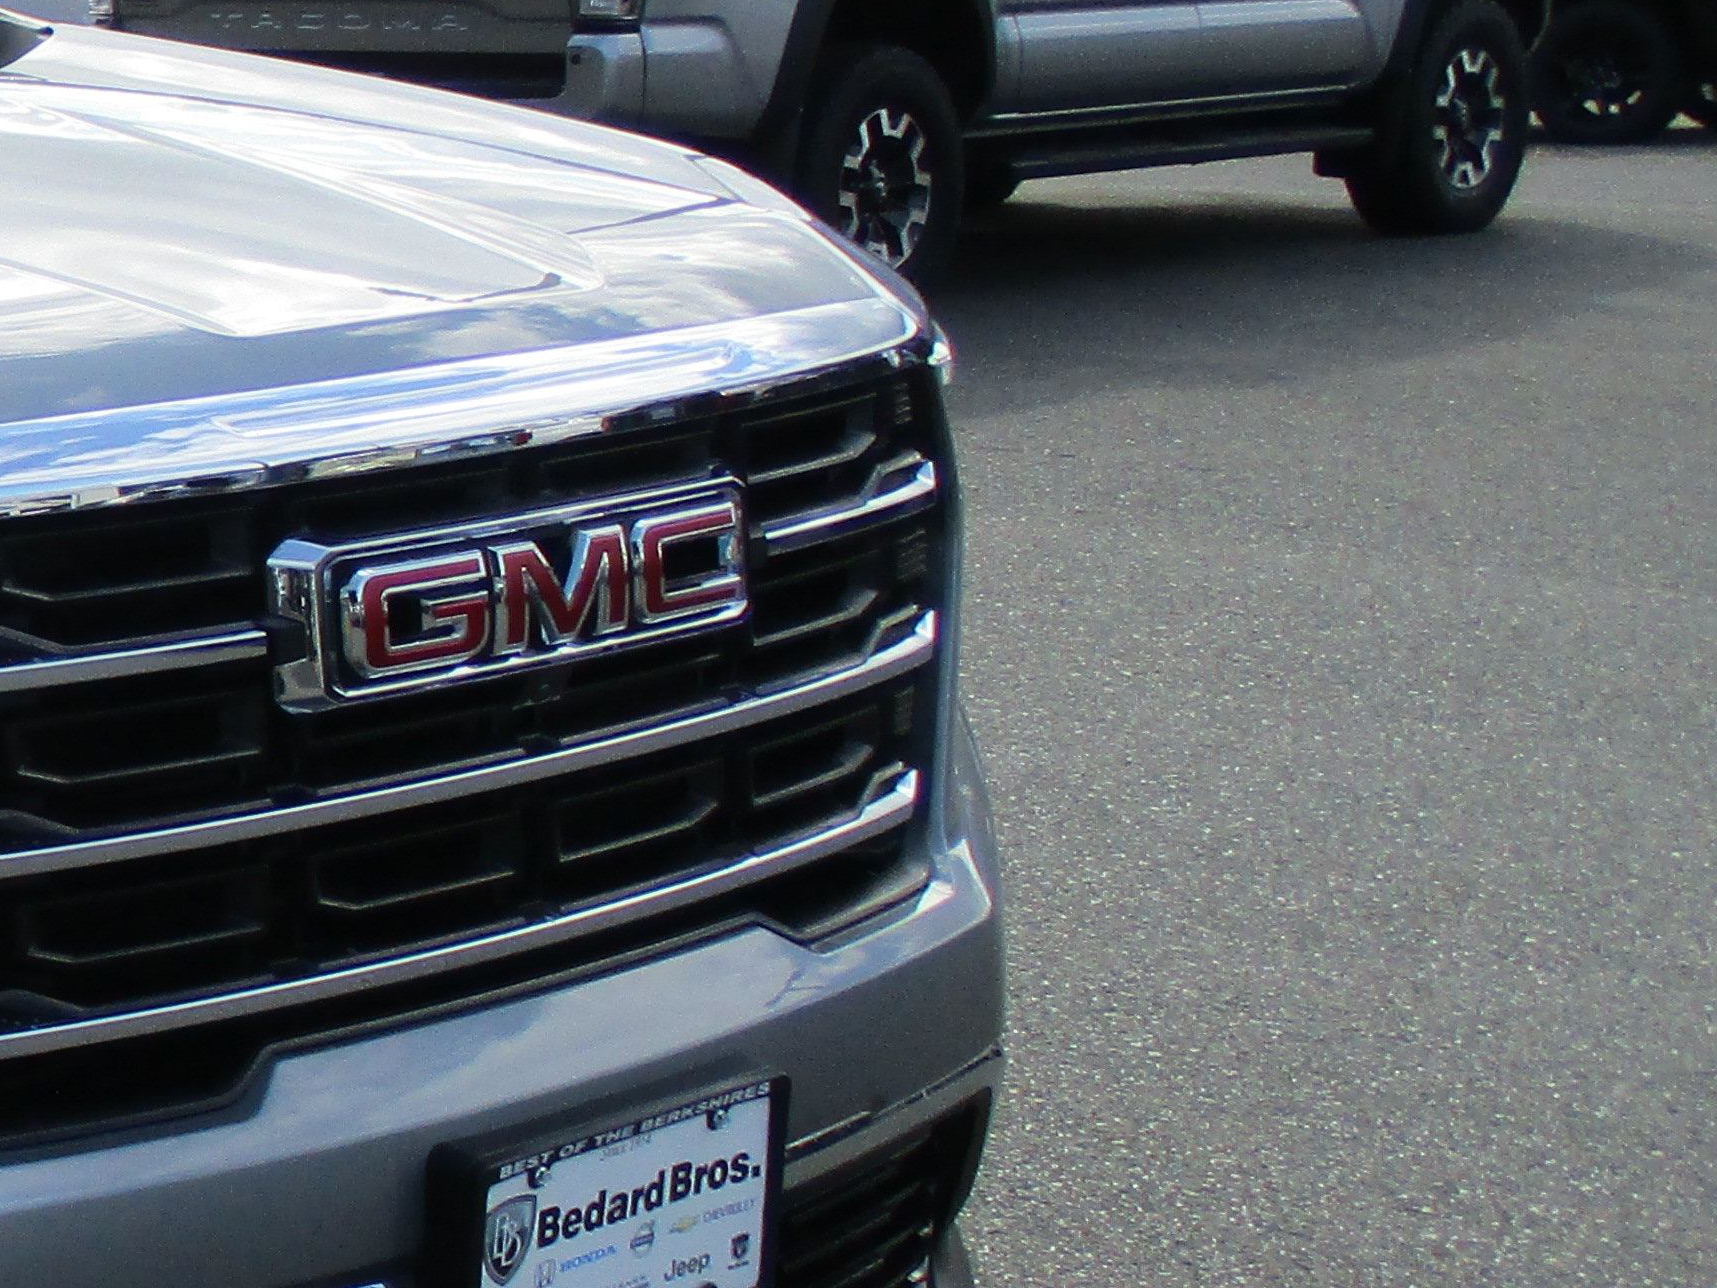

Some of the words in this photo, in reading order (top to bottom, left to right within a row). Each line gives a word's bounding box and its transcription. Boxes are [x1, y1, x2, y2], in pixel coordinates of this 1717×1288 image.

[210, 13, 469, 32] TACOMA
[342, 500, 746, 679] GMC
[499, 1150, 555, 1180] BEST
[558, 1138, 589, 1158] OF
[594, 1123, 636, 1147] THE
[640, 1080, 770, 1132] BERKSHIRES
[536, 1169, 666, 1249] Bedard
[669, 1152, 761, 1203] Bros.
[560, 1245, 618, 1272] HONDA
[664, 1253, 710, 1282] Jeep
